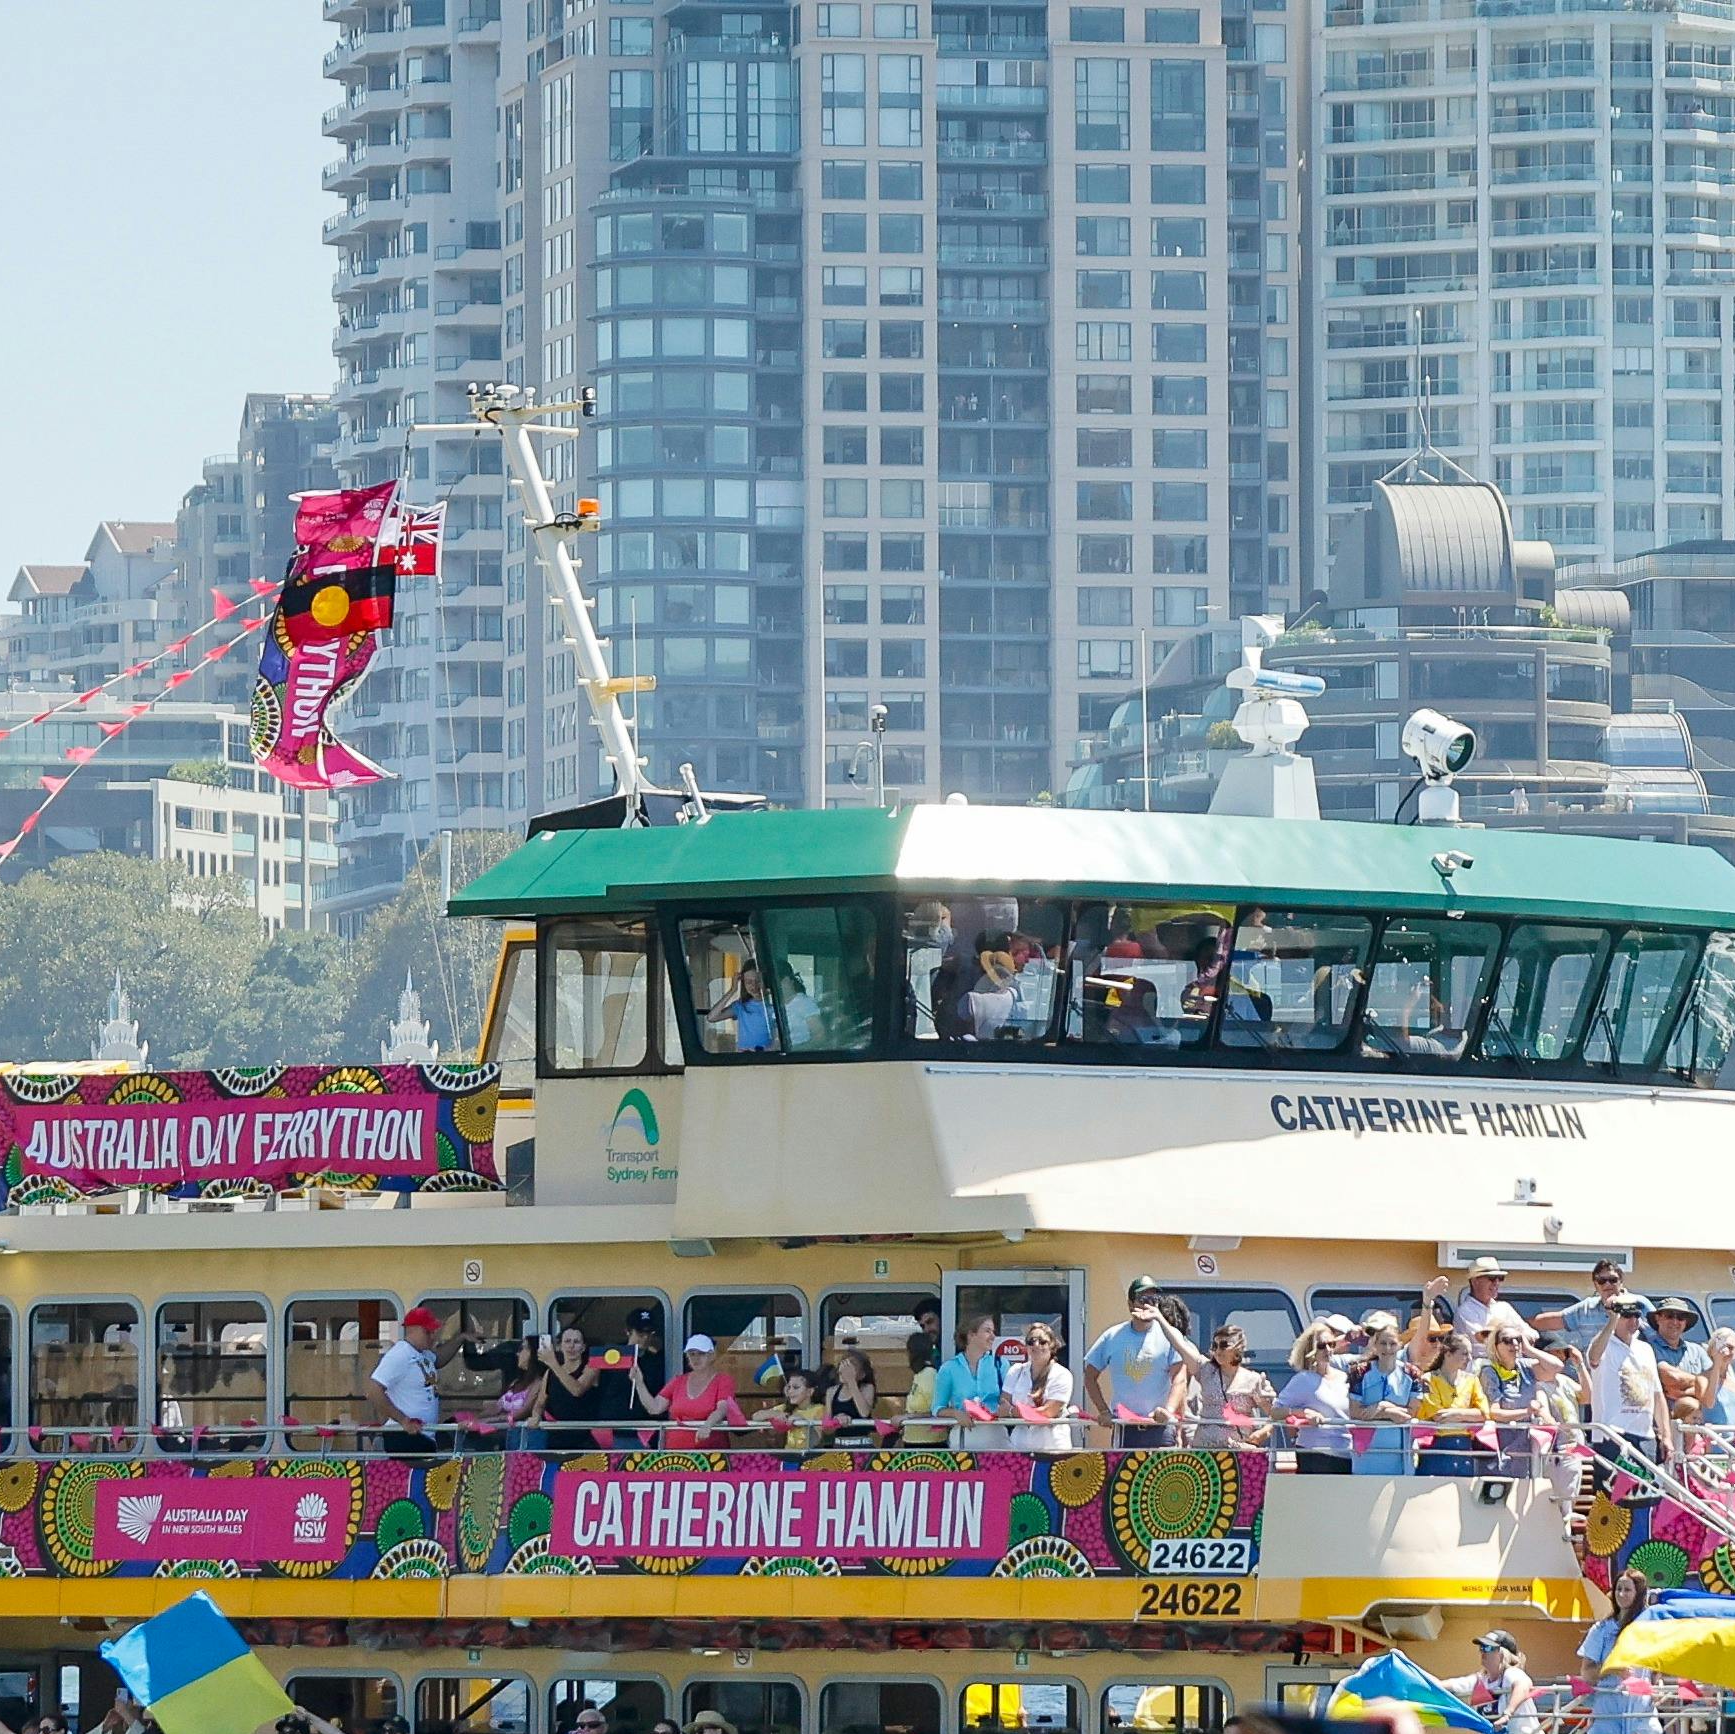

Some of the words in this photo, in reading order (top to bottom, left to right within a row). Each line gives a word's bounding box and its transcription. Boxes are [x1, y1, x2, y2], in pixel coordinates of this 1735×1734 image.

[1269, 1093, 1468, 1136] CATHERINE
[1470, 1101, 1588, 1140] HAMLIN
[24, 1116, 180, 1170] AUSTRALIA
[188, 1111, 248, 1168] DAY
[253, 1106, 424, 1165] FERRYTHON
[606, 1149, 659, 1164] Transport
[607, 1166, 649, 1183] Sydney
[652, 1166, 678, 1180] Ferri
[1004, 1345, 1020, 1354] NO
[162, 1508, 223, 1522] AUSTRALIA
[225, 1508, 249, 1522] DAY
[572, 1480, 806, 1547] CATHERINE
[816, 1480, 985, 1547] HAMLIN
[161, 1525, 171, 1534] IN
[172, 1525, 189, 1534] NEW
[190, 1525, 216, 1534] SOUTH
[217, 1525, 243, 1534] WALES
[293, 1520, 327, 1537] NSW
[1153, 1542, 1246, 1569] 24622
[1139, 1583, 1242, 1616] 24622
